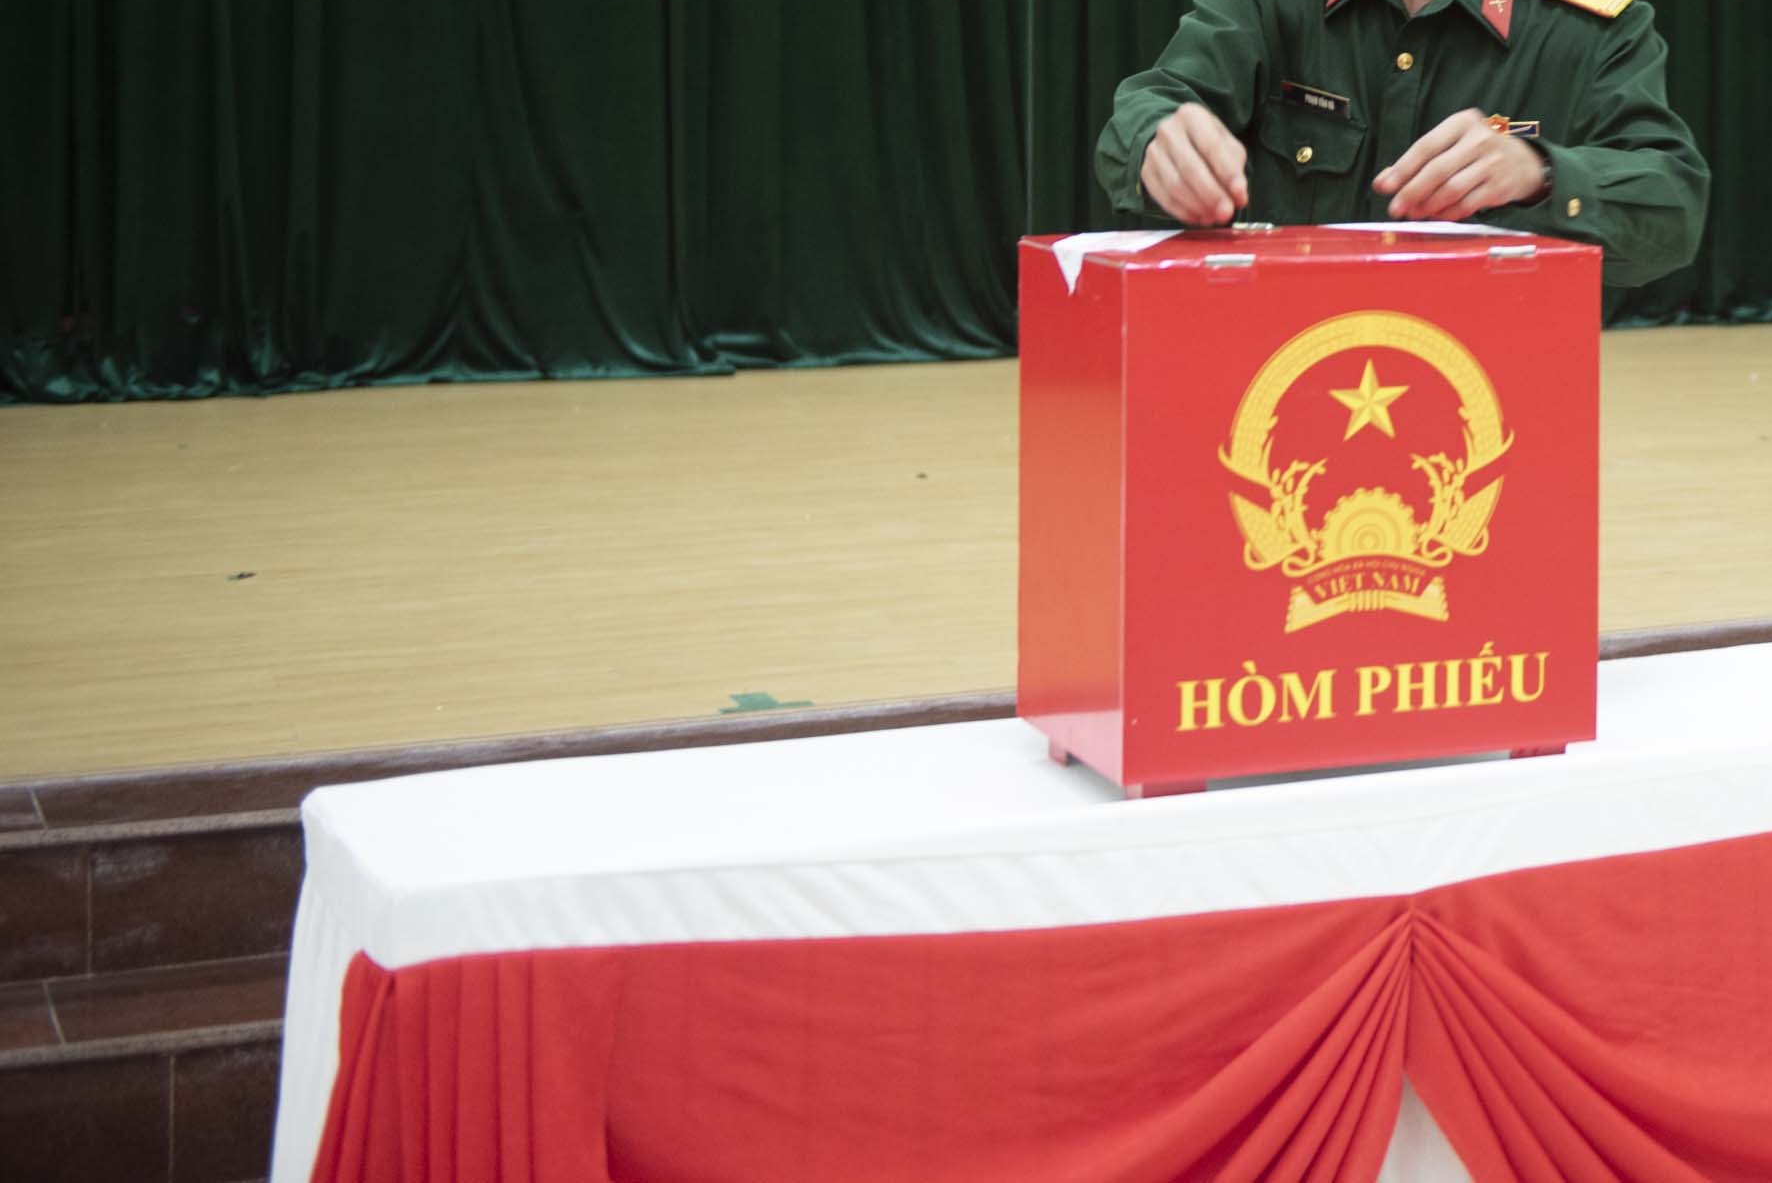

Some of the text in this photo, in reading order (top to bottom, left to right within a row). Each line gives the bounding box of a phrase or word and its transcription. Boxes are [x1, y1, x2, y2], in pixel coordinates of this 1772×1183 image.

[1371, 571, 1421, 594] NAM
[1176, 640, 1549, 733] HÒM PHIẾU
